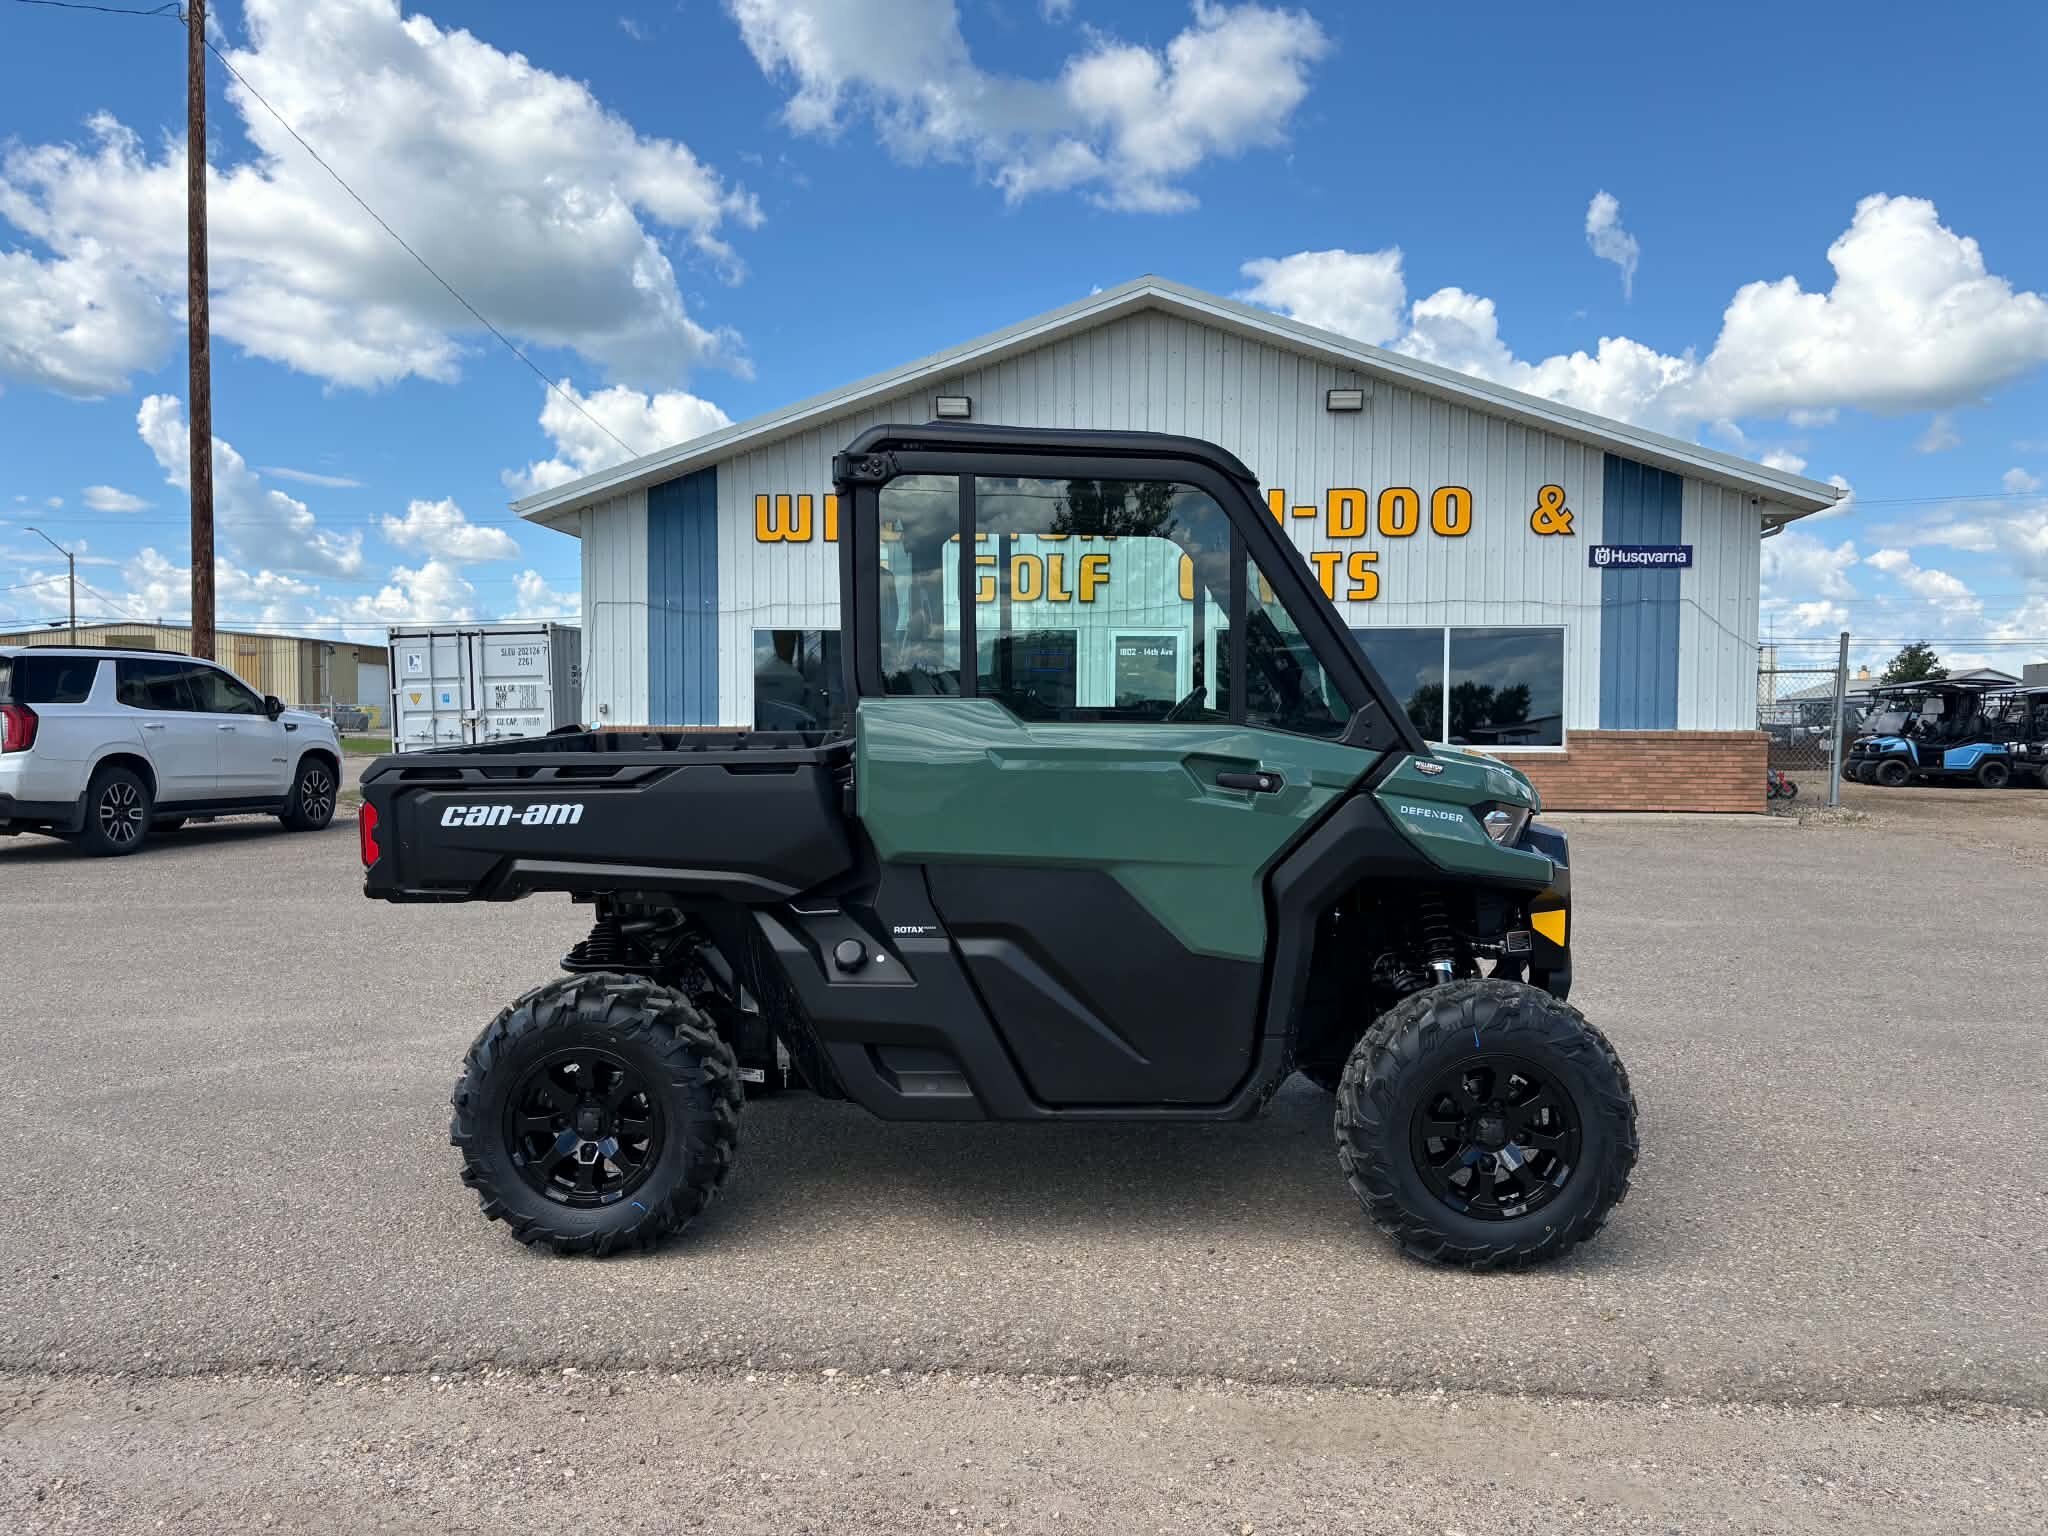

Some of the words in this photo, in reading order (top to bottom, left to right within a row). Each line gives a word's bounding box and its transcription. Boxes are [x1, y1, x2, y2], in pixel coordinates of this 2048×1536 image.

[1267, 486, 1473, 538] I-DOO
[1530, 484, 1575, 535] &
[1612, 549, 1687, 564] Husqvarna
[974, 553, 1112, 602] GOLF
[1144, 648, 1159, 656] 14th
[1160, 648, 1174, 656] Ave
[440, 803, 584, 827] can-am
[1400, 805, 1464, 823] DEFENDER
[893, 926, 924, 934] ROTAX
